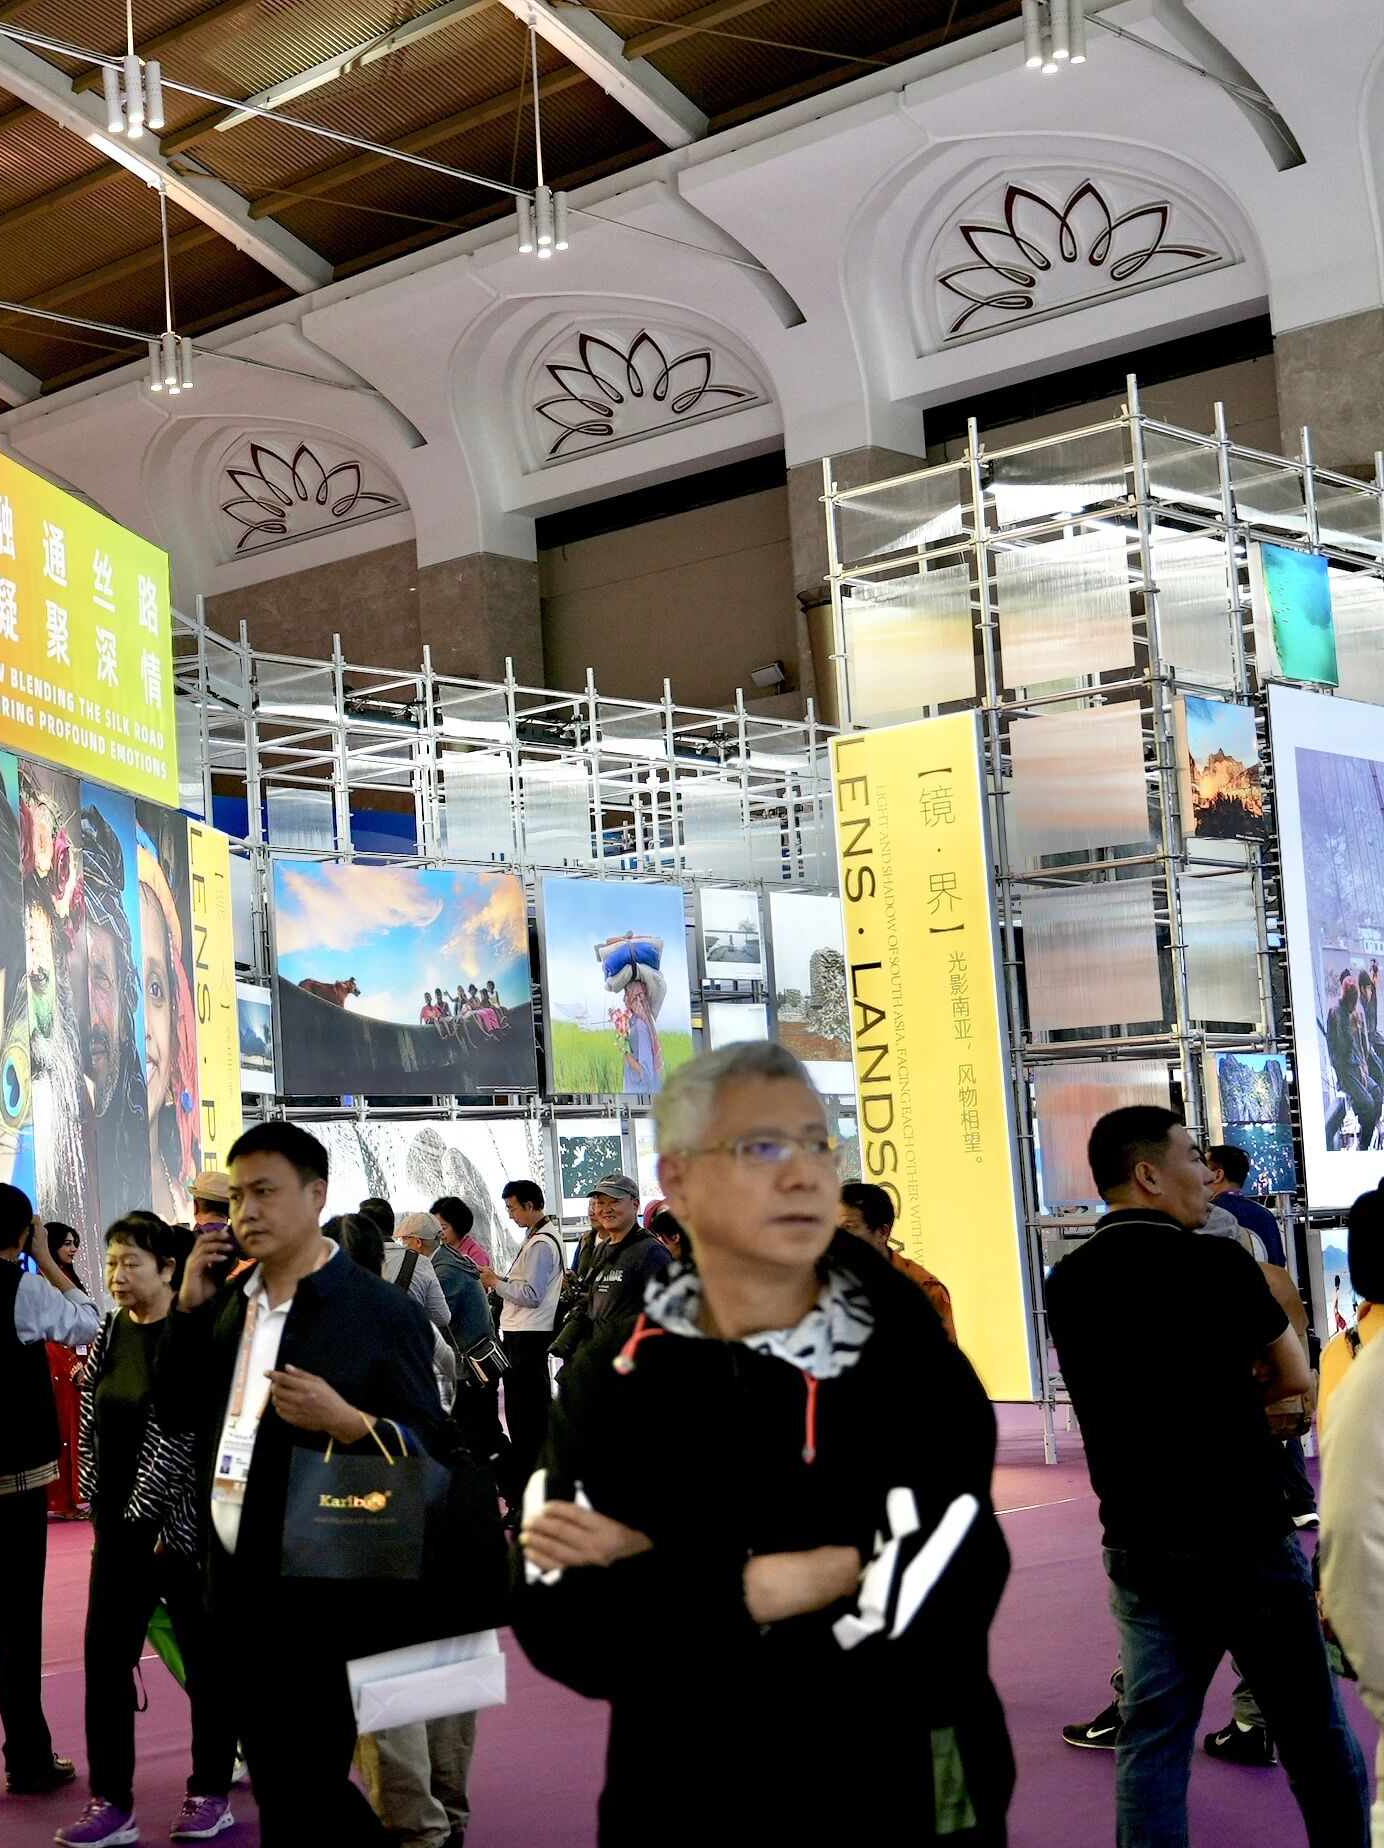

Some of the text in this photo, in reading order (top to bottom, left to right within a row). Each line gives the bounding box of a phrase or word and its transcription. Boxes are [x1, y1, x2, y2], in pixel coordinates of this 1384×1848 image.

[10, 667, 75, 713] BLENDING
[79, 697, 101, 724] THE
[105, 709, 130, 737] SILK
[134, 721, 164, 750] ROAD
[39, 711, 106, 755] PROFOUND
[110, 740, 167, 780] EMOTIONS
[835, 736, 876, 902] LENS
[876, 785, 889, 828] LIGHT
[879, 832, 892, 863] AND
[881, 866, 898, 932] SHADOW
[190, 827, 211, 1025] LENS
[887, 934, 900, 956] OF
[889, 956, 904, 1008] SOUTH
[896, 1048, 912, 1102] FACING
[900, 1107, 915, 1147] EACH
[904, 1150, 920, 1202] OTHER
[909, 1204, 923, 1246] WITH
